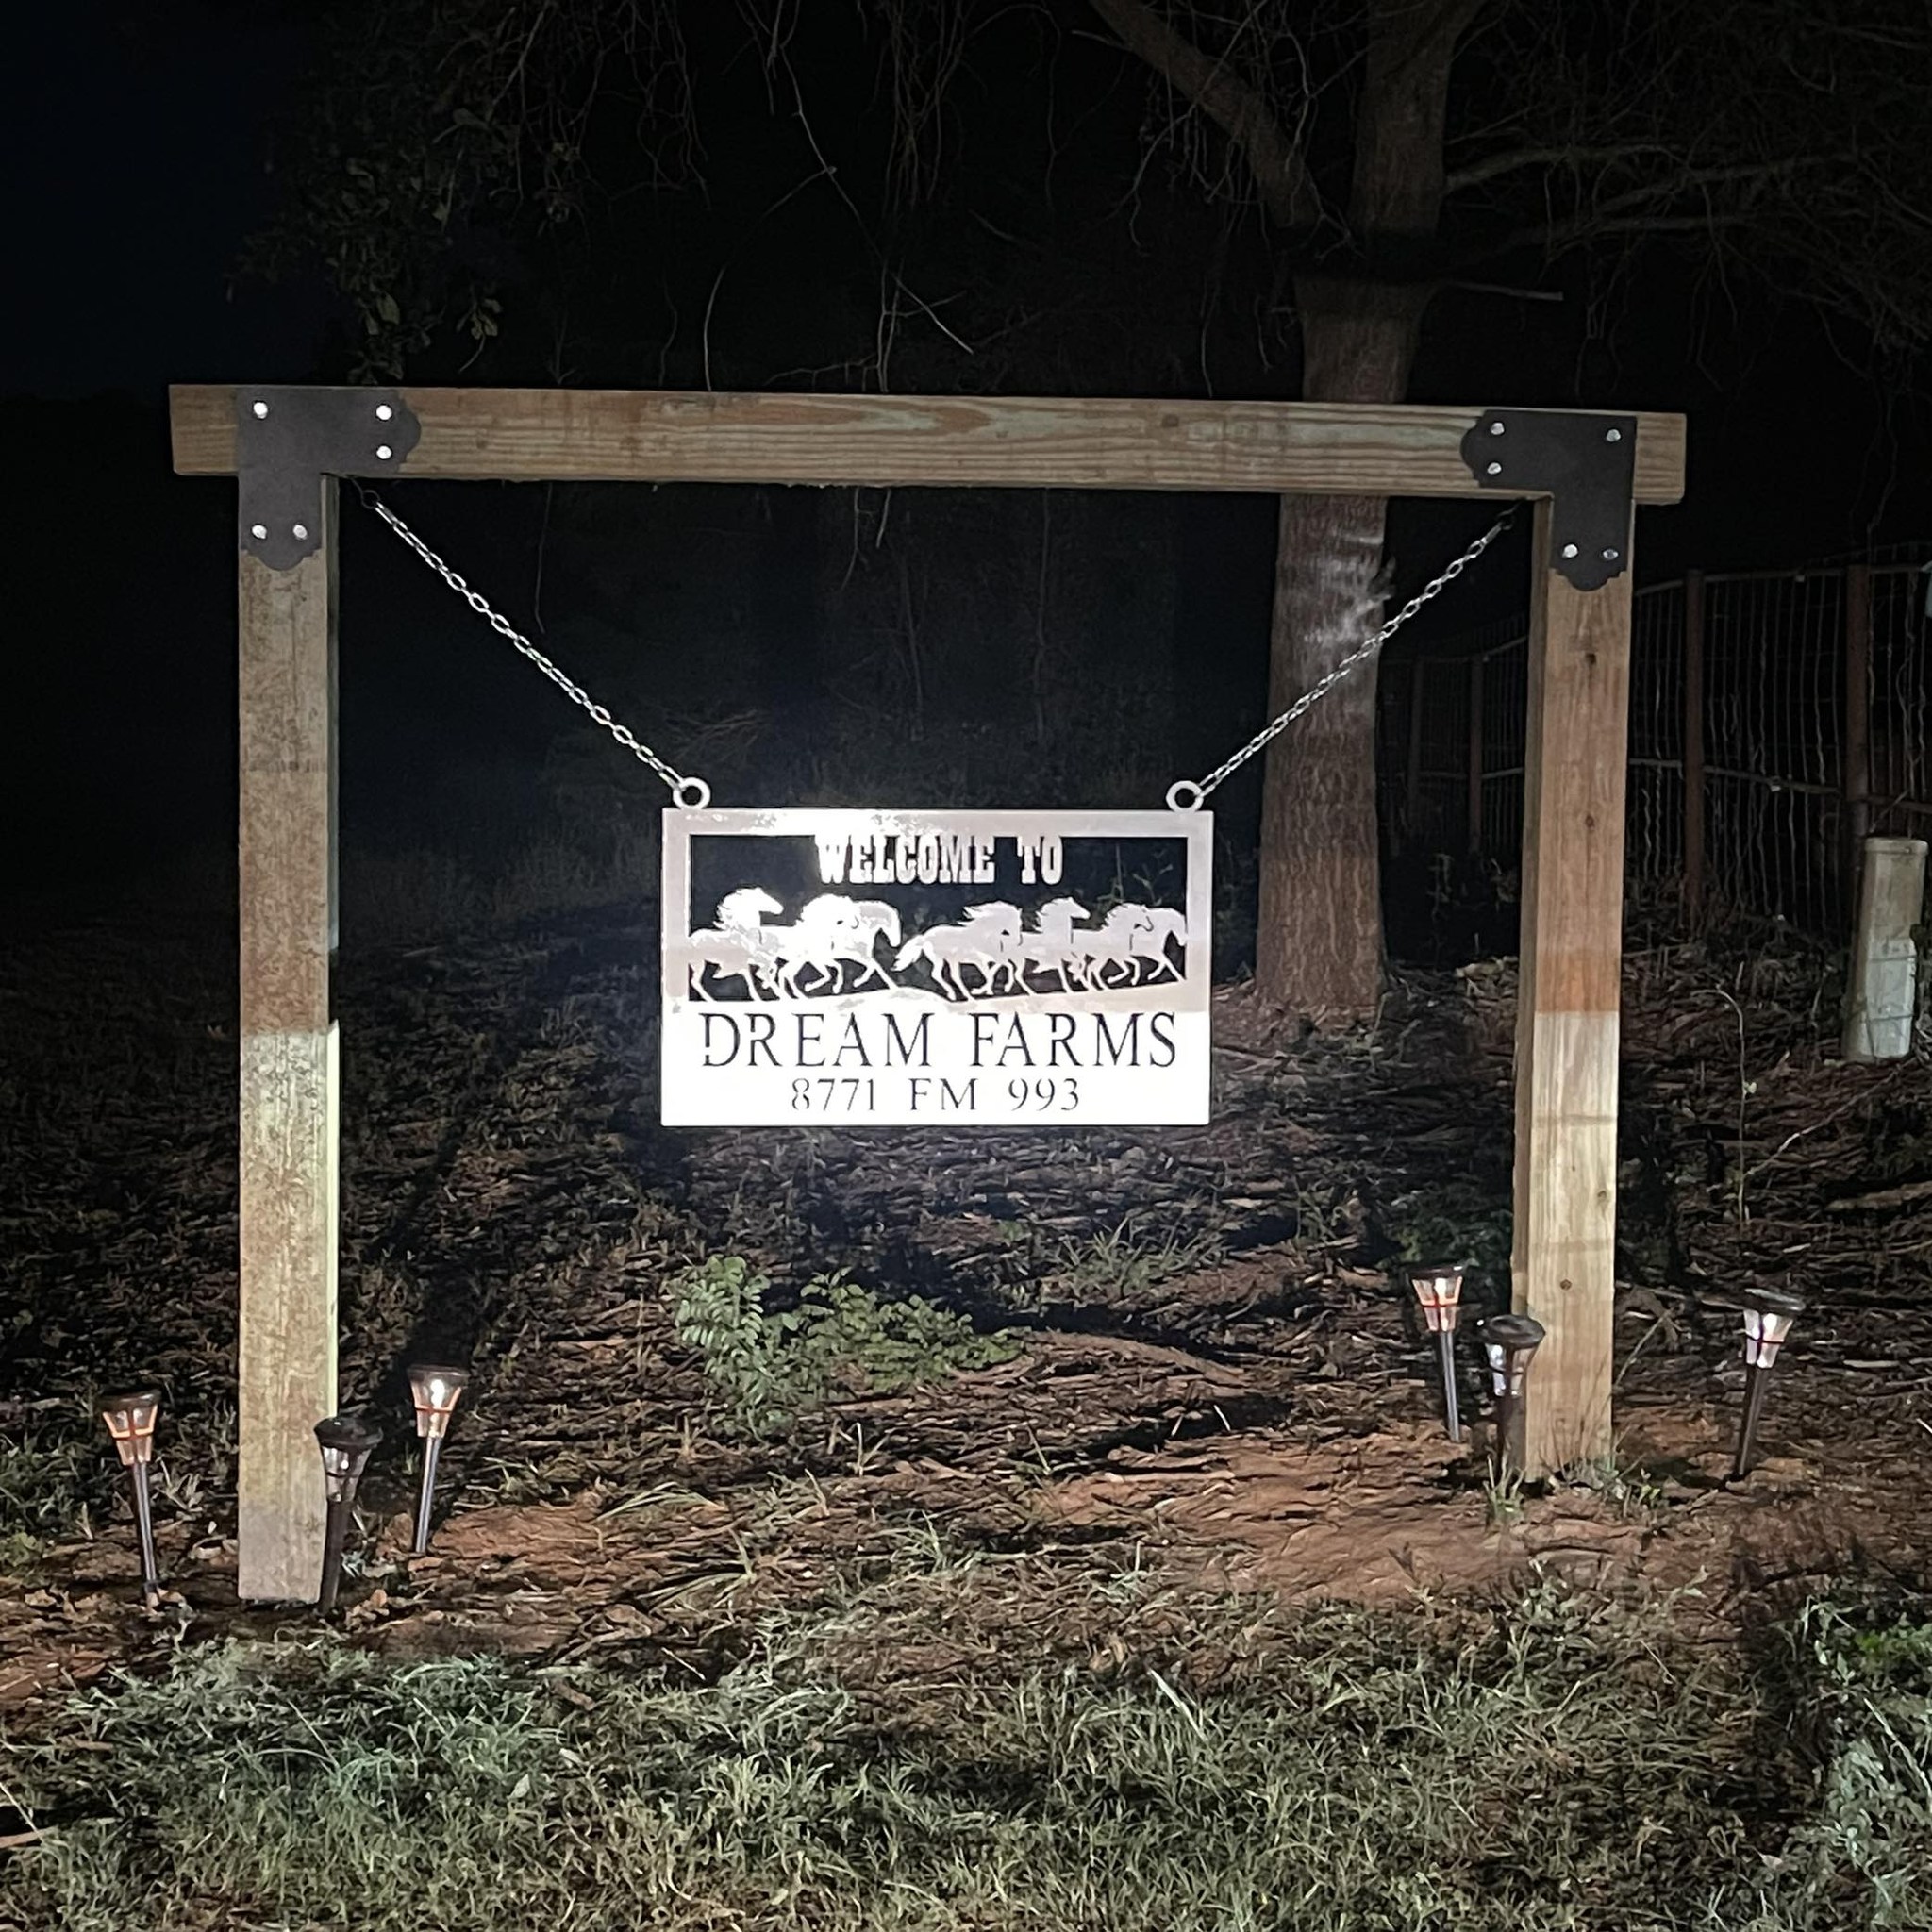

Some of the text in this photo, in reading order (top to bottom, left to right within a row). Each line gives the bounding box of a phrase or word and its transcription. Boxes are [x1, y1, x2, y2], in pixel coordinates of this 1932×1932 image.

[815, 834, 1063, 885] WELCOME TO
[698, 1010, 1176, 1068] DREAM FARMS
[791, 1077, 1079, 1111] 8771 FM 993
